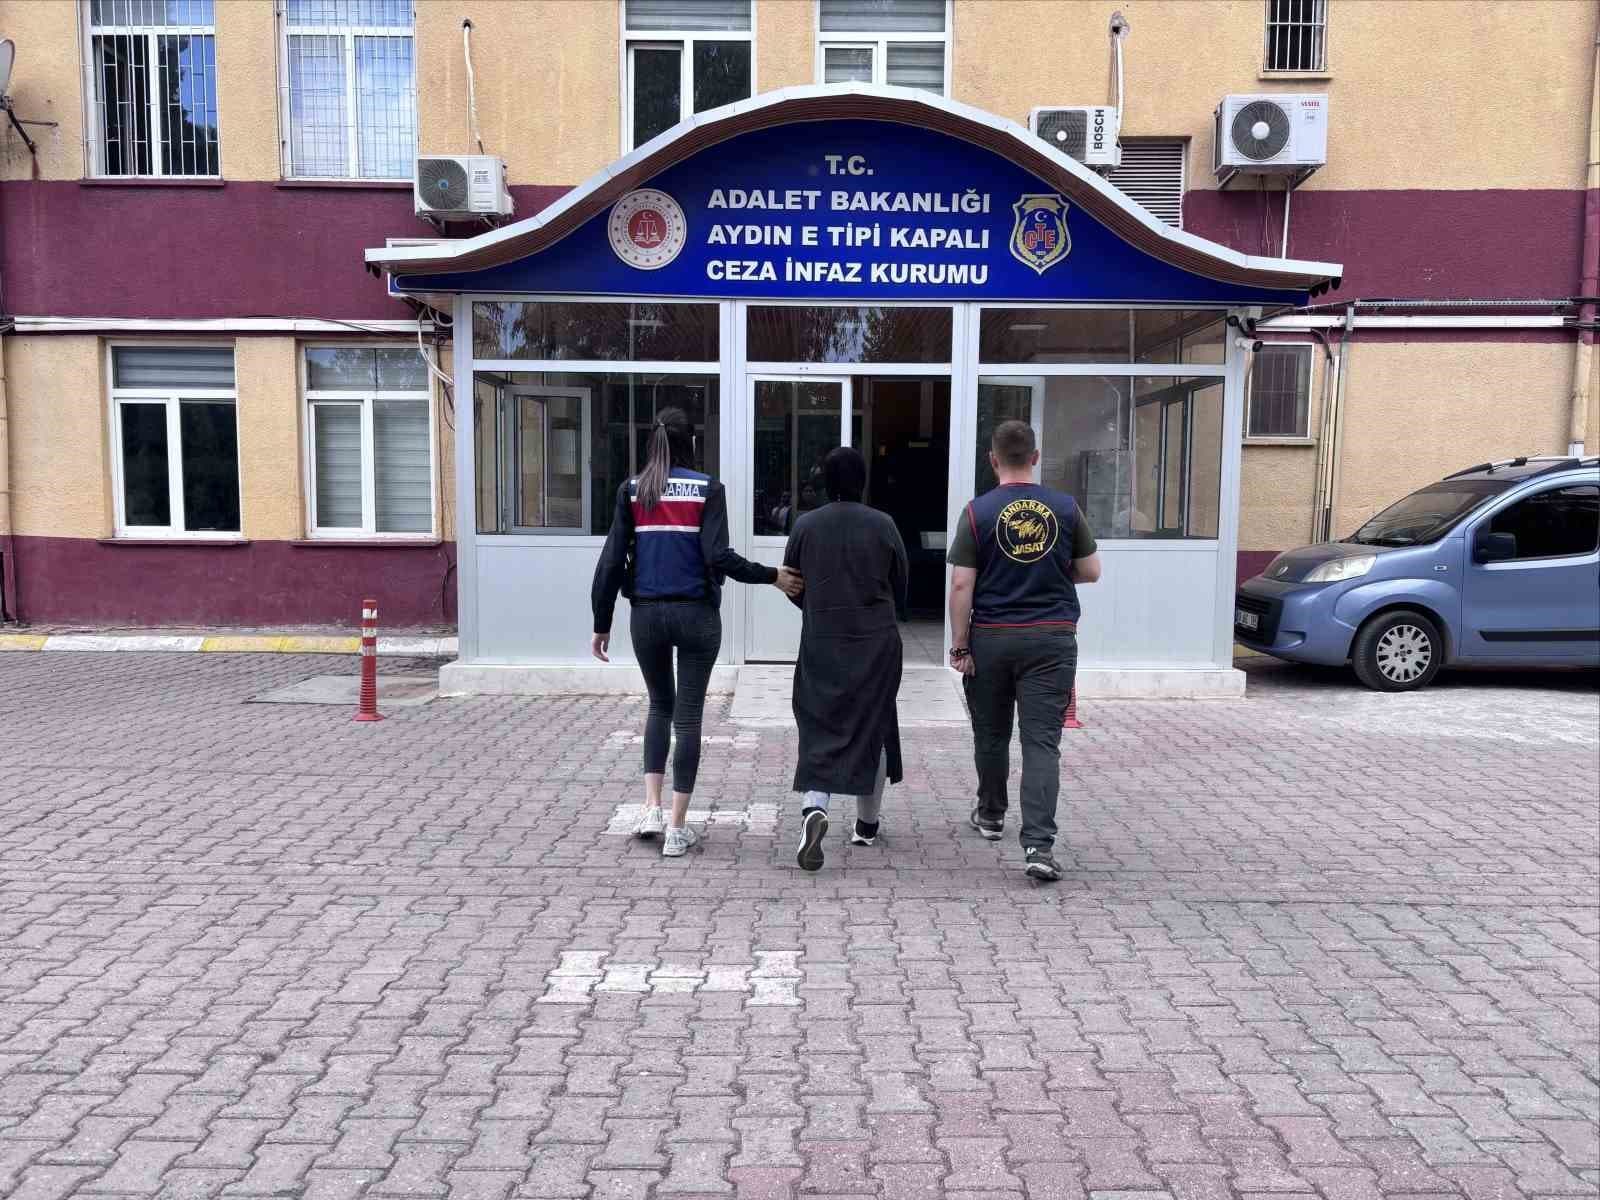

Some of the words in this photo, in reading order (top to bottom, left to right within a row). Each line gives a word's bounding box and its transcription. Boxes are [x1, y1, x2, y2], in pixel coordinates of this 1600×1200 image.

[1093, 109, 1106, 150] BOSCH
[824, 155, 874, 176] T.C.
[707, 189, 822, 210] ADALET
[830, 188, 991, 214] BAKANLIĞI
[706, 224, 792, 246] AYDIN
[801, 225, 819, 246] E
[826, 221, 882, 247] TİPİ
[890, 227, 990, 249] KAPALI
[706, 259, 778, 281] CEZA
[785, 256, 863, 283] İNFAZ
[870, 262, 989, 285] KURUMU
[1000, 501, 1051, 522] JANDARMA
[1012, 542, 1046, 555] JASAT
